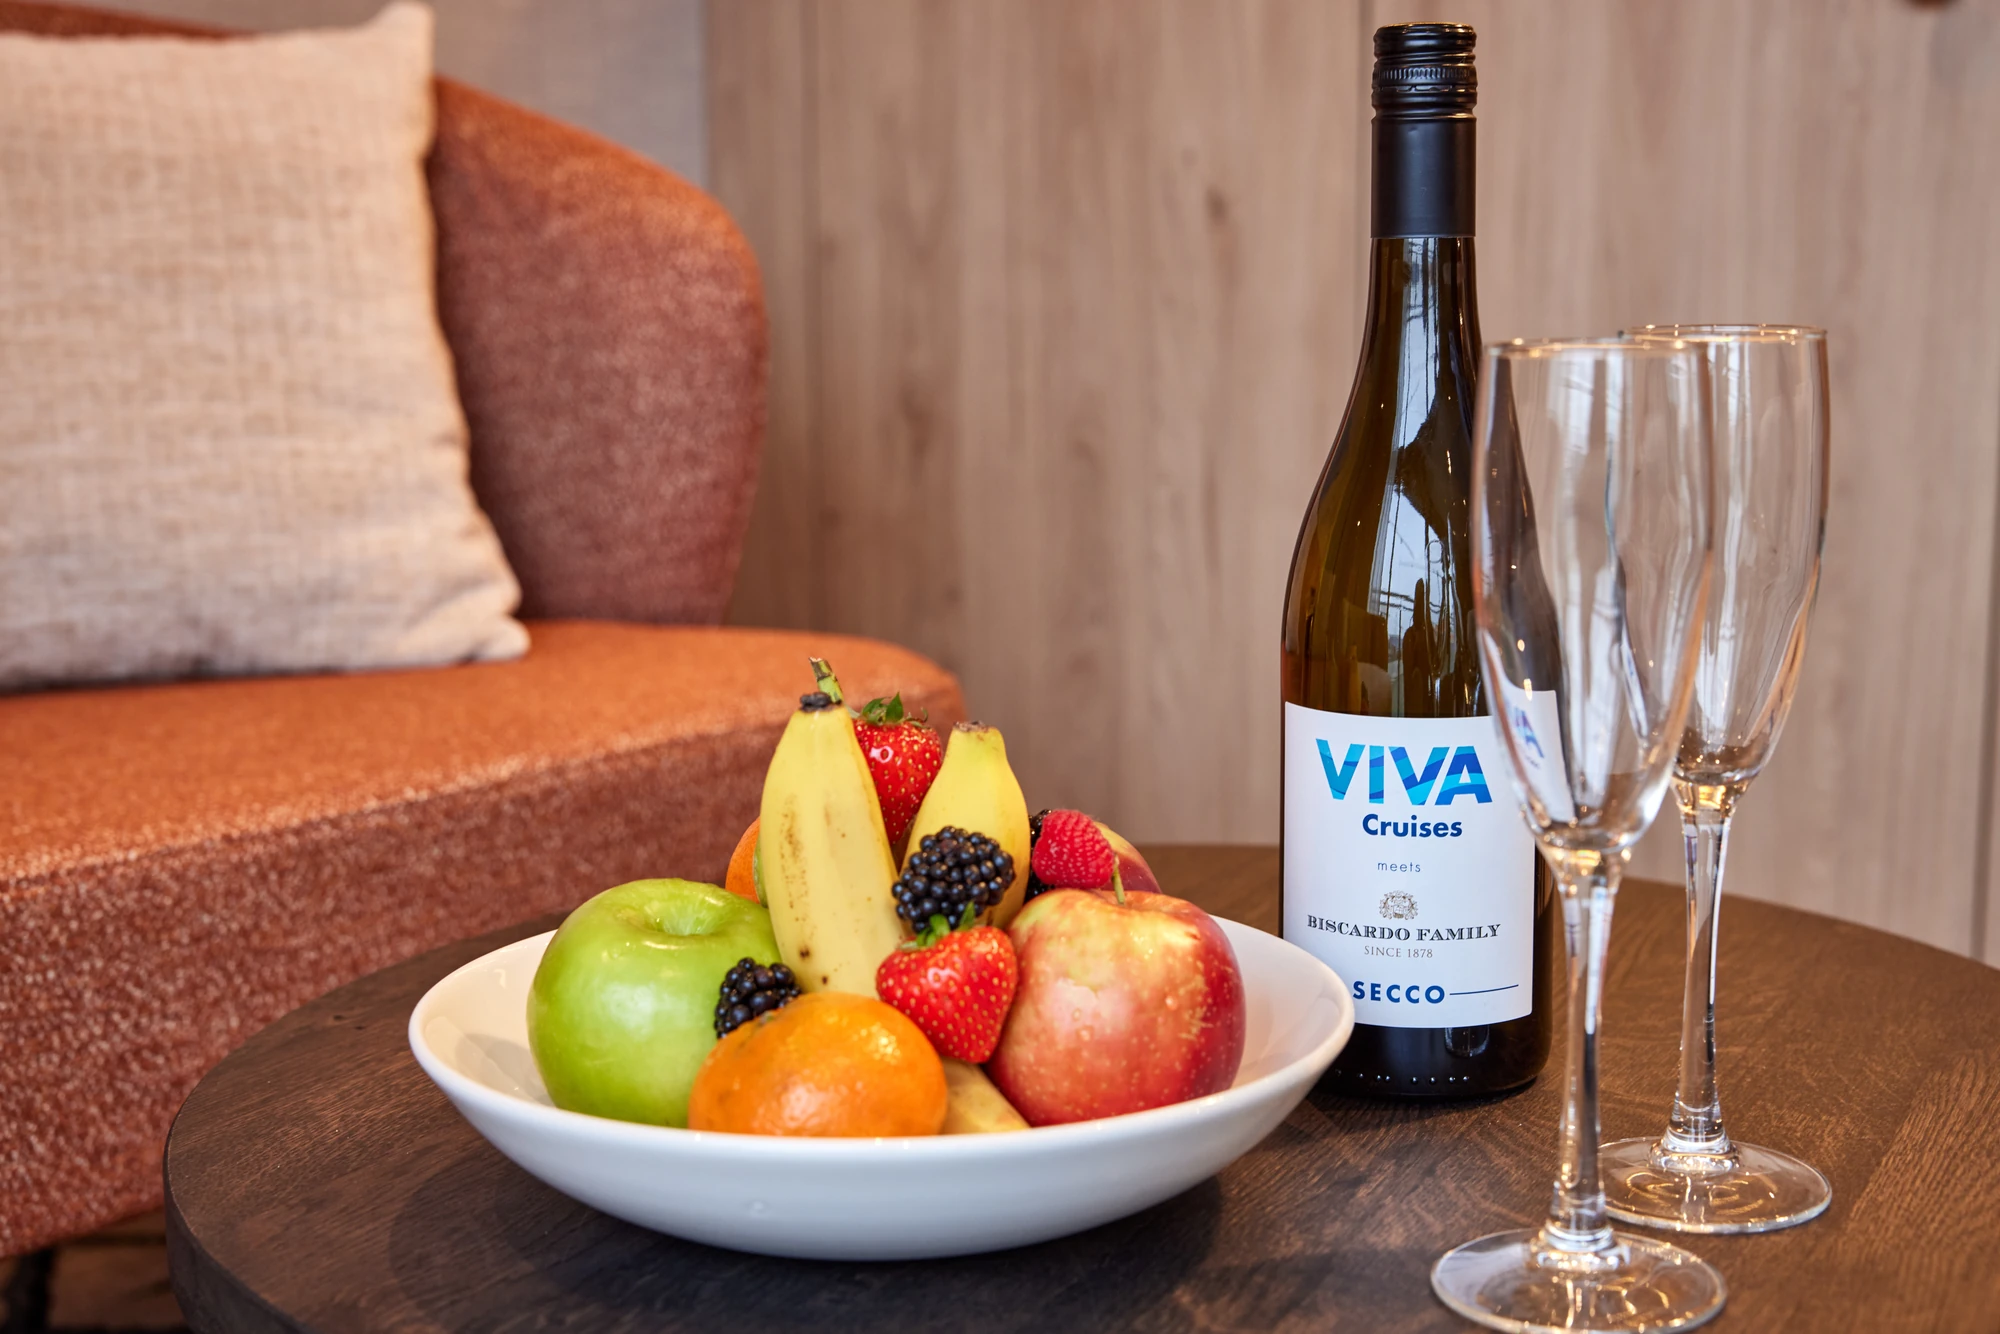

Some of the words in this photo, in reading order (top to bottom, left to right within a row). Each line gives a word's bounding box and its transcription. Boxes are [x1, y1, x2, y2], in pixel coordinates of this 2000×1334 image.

[1315, 738, 1493, 806] VIVA
[1362, 813, 1463, 838] Cruises
[1377, 861, 1421, 873] meets
[1307, 915, 1410, 941] BISCARDO
[1416, 924, 1501, 942] FAMILY
[1364, 945, 1401, 959] SINCE
[1407, 947, 1433, 959] 1878
[1353, 981, 1445, 1004] SECCO
